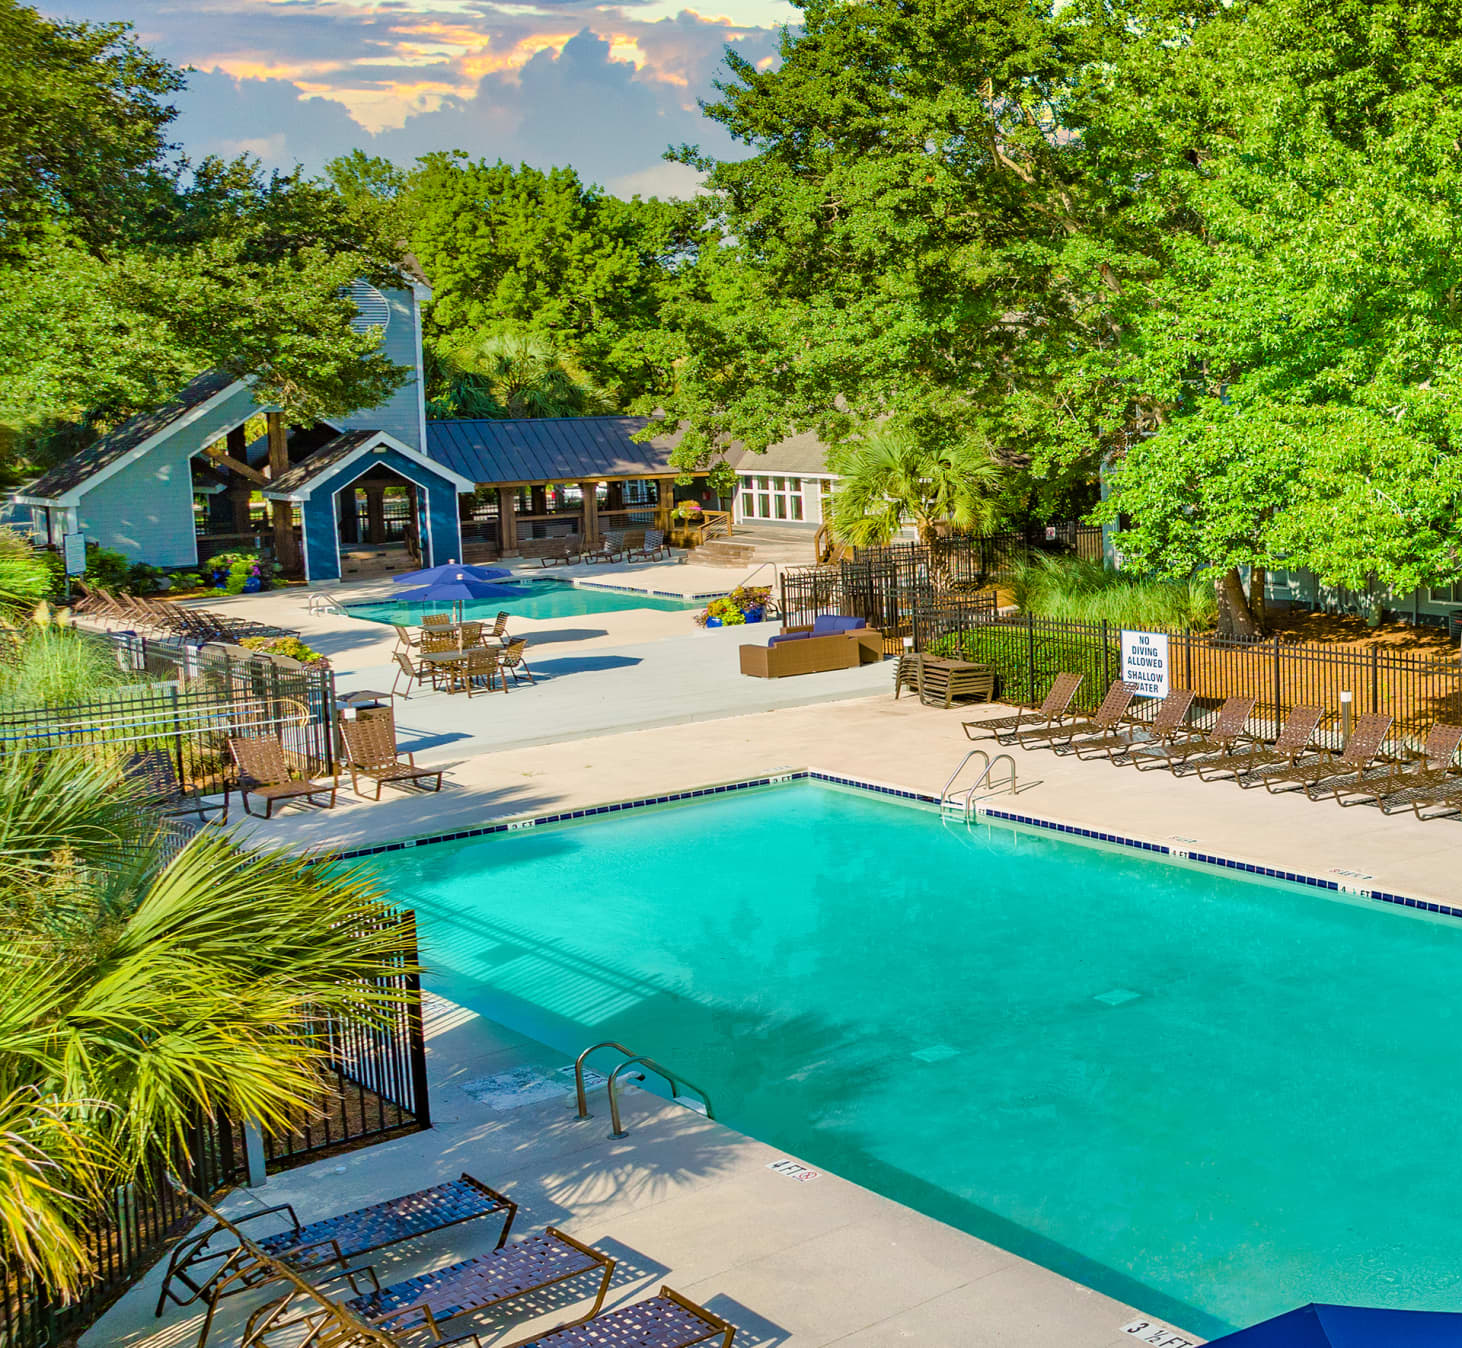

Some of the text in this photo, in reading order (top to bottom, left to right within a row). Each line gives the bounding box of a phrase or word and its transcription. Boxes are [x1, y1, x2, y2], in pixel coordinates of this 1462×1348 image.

[1139, 636, 1150, 645] NO
[1131, 645, 1158, 657] DIVING
[1127, 656, 1163, 668] ALLOWED
[1127, 670, 1163, 683] SHALLOW
[779, 1164, 808, 1176] FT
[1127, 1322, 1149, 1333] 3
[1159, 1336, 1194, 1348] FT
